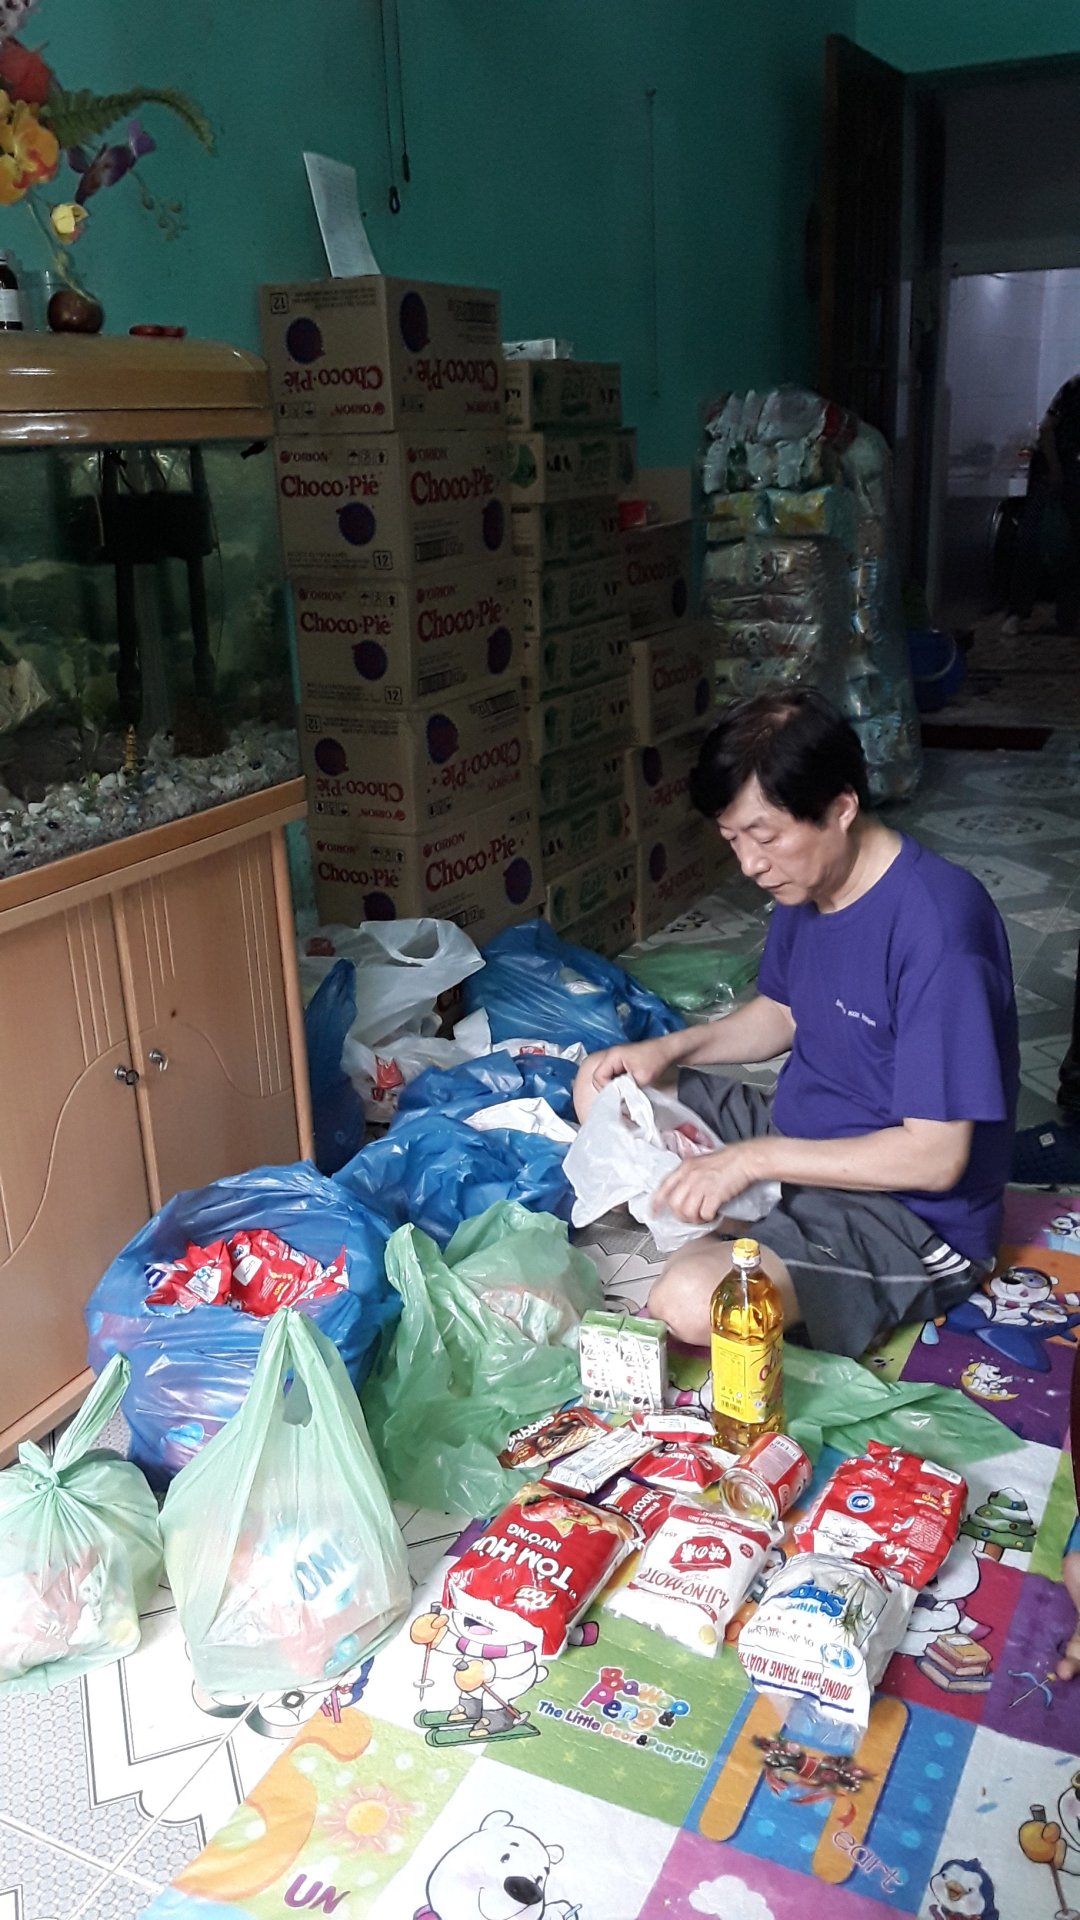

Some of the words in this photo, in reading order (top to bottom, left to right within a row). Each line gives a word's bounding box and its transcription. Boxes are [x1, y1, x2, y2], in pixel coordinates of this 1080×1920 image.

[505, 1522, 563, 1553] NƯỚNG
[515, 1547, 575, 1592] TÔM
[538, 1701, 564, 1719] The
[565, 1709, 601, 1731] Little
[646, 1736, 708, 1768] Penguin
